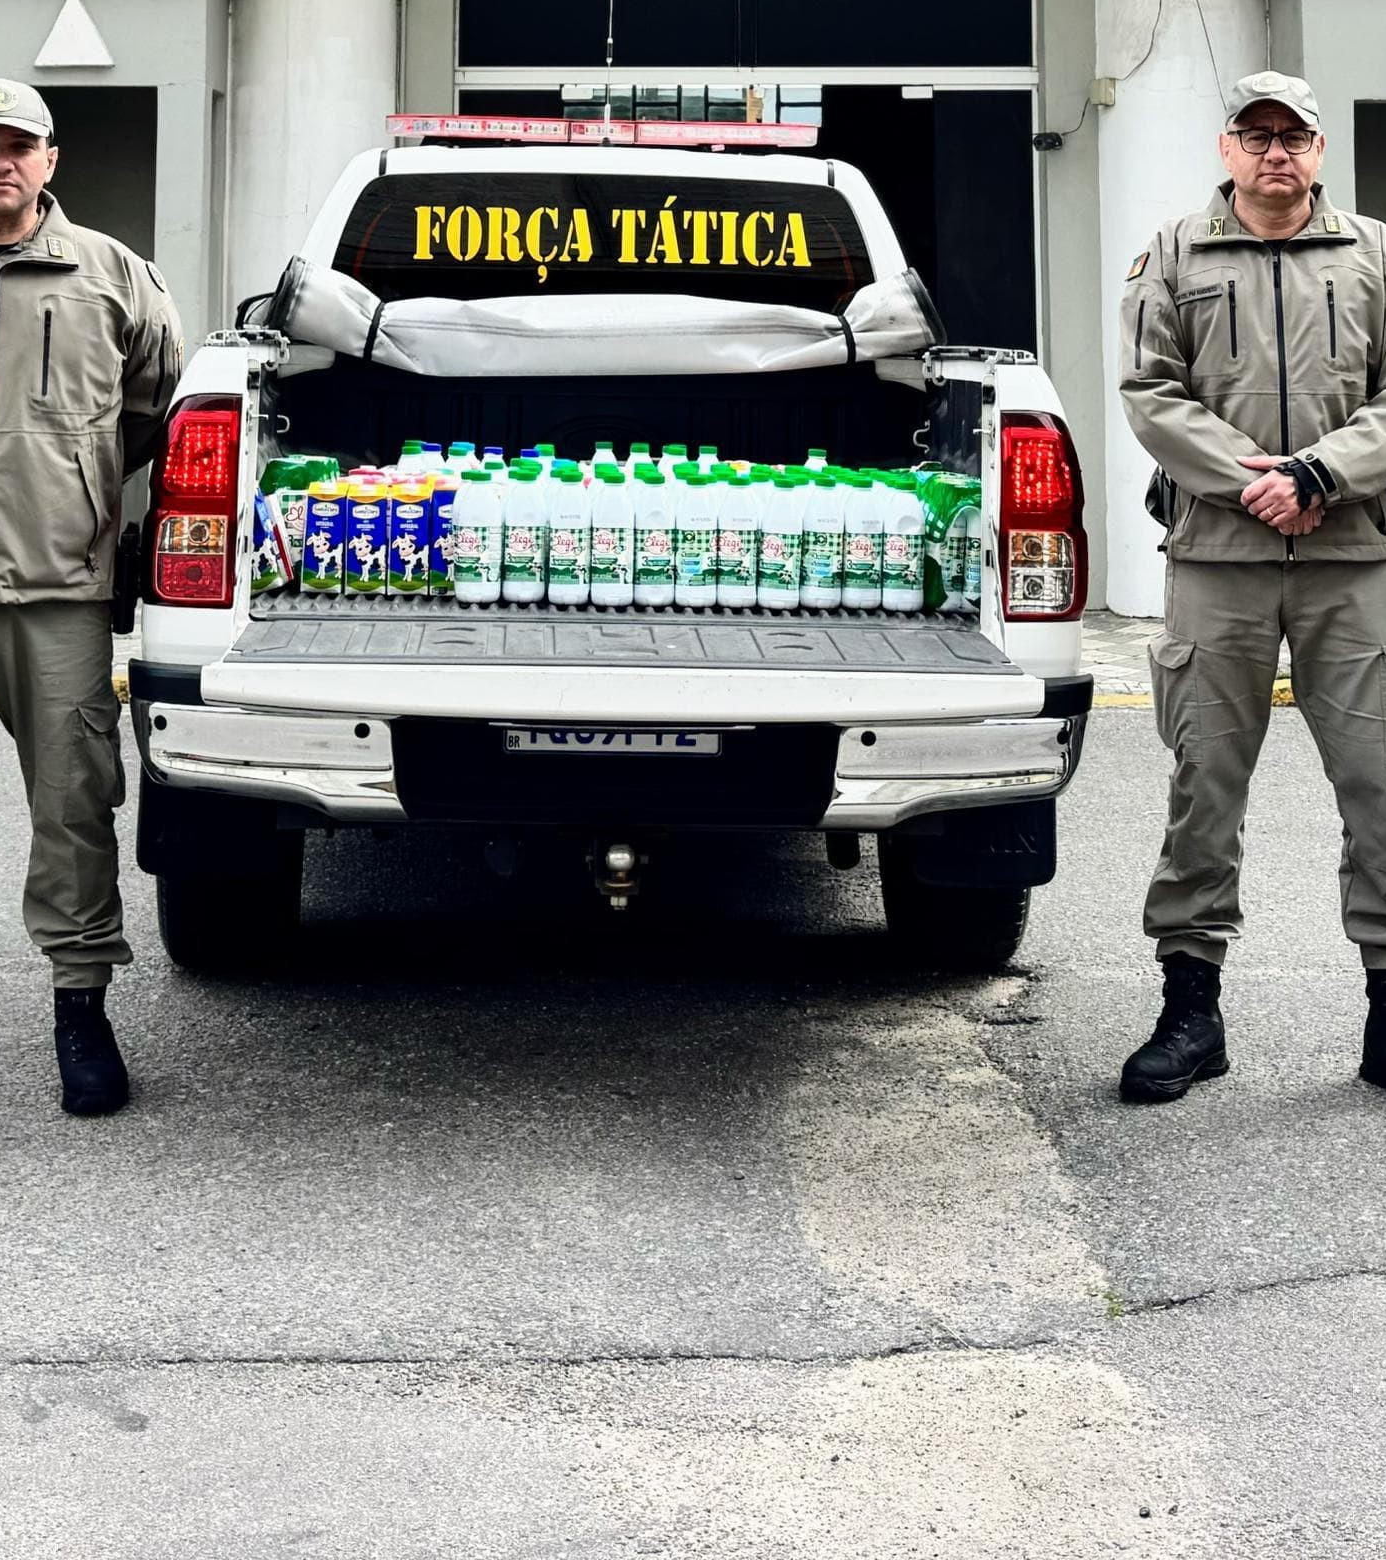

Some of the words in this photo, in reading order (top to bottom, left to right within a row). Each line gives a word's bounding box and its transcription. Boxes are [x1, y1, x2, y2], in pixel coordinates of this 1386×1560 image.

[413, 205, 593, 281] FORÇA
[611, 195, 811, 268] TÁTICA
[509, 735, 520, 748] BR
